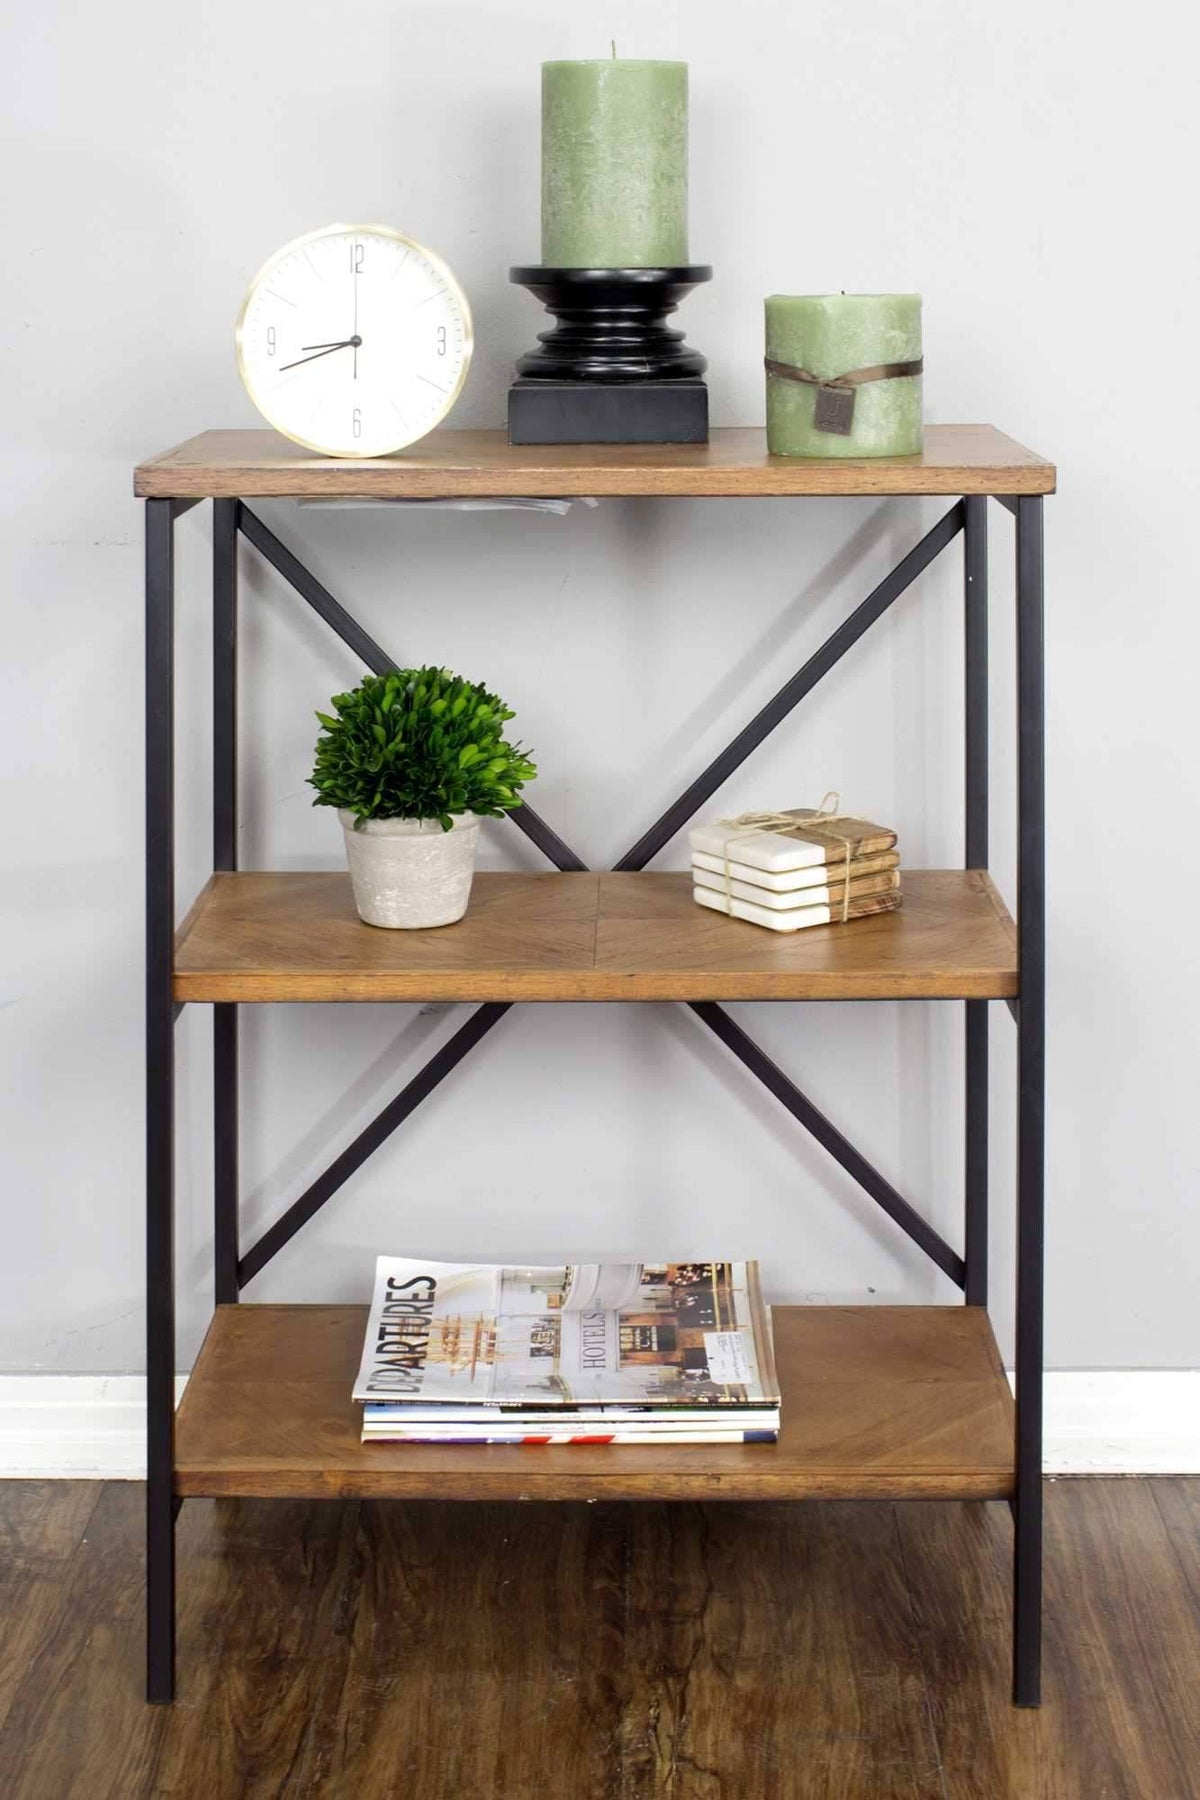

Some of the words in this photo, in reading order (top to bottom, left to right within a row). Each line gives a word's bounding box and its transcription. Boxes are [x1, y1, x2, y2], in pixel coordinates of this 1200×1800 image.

[349, 243, 365, 274] 12
[267, 326, 276, 356] 9
[437, 326, 447, 356] 3
[352, 408, 362, 438] 6
[583, 1312, 606, 1368] HOTELS
